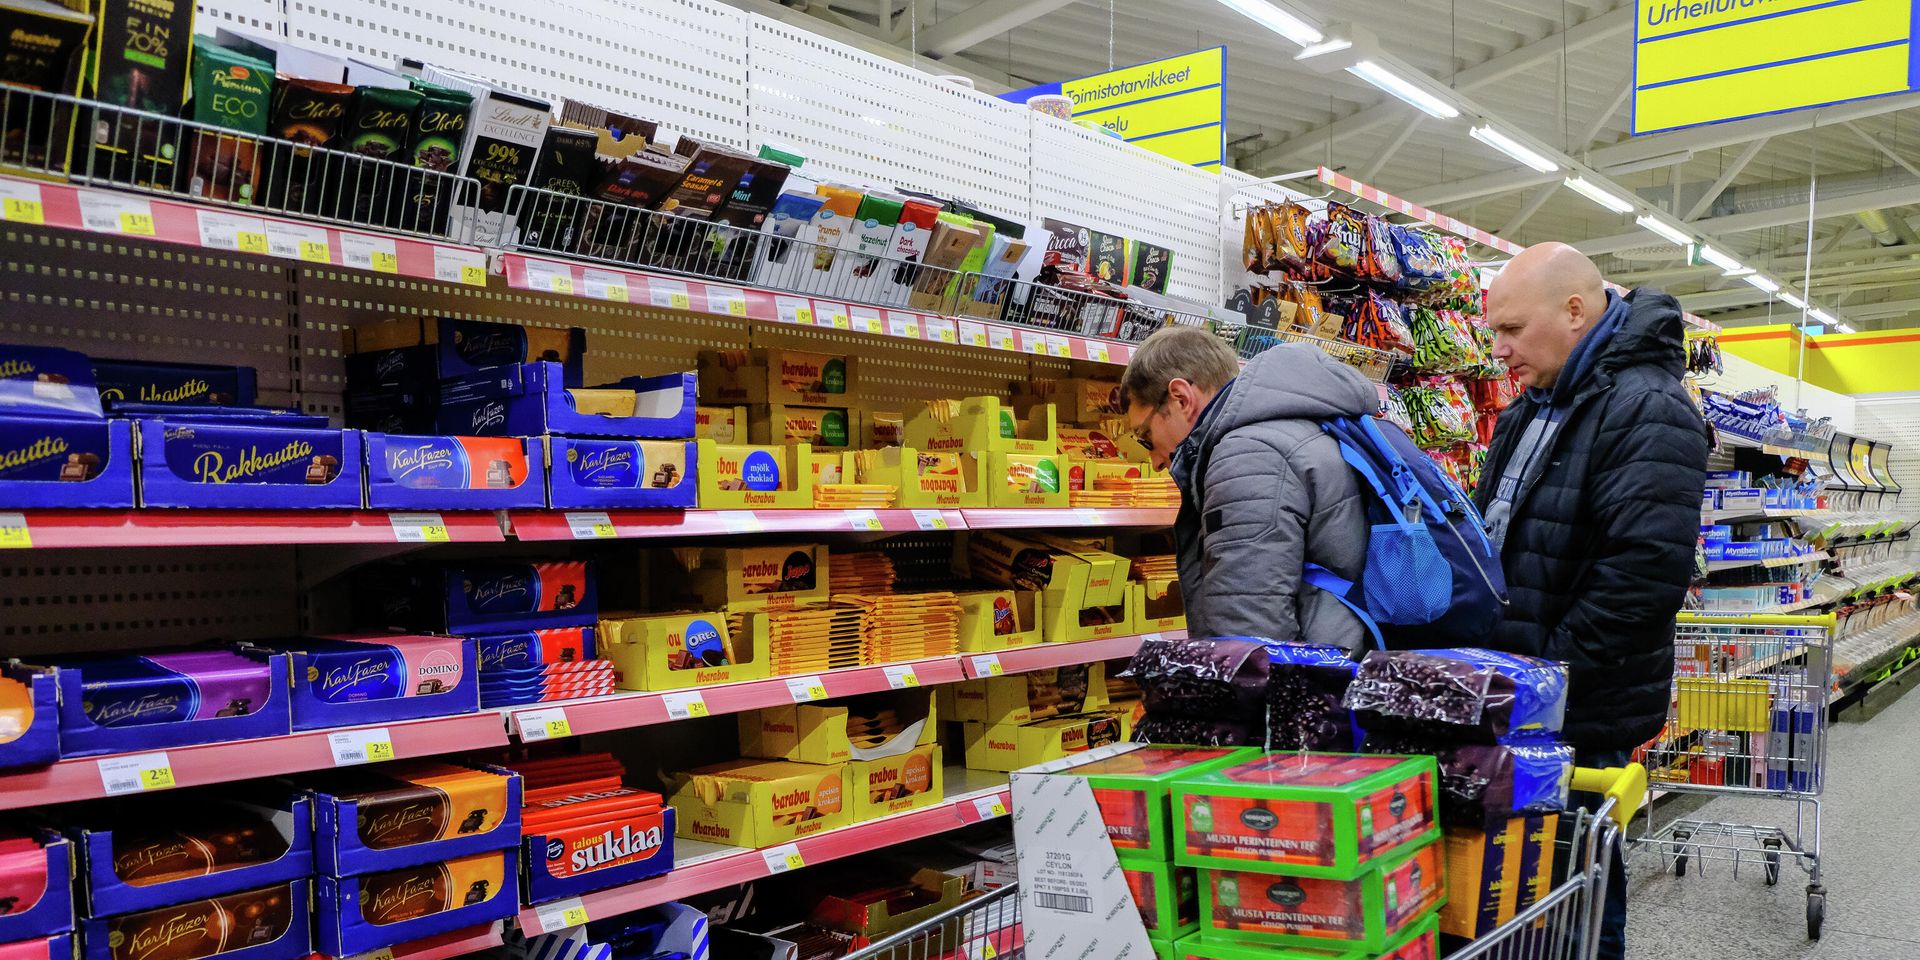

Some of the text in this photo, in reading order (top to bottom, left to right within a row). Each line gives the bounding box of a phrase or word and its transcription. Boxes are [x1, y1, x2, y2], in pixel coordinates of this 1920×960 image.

[127, 17, 170, 39] FIN
[126, 31, 168, 57] 70%
[1066, 66, 1191, 105] Toimistotarvikkeet
[212, 94, 258, 118] ECO
[289, 100, 344, 120] Chef's
[359, 110, 409, 130] Chef's
[419, 111, 465, 132] Chef's
[490, 106, 533, 126] Lindt
[484, 125, 537, 143] EXCELLENCE
[486, 143, 520, 165] 99%
[686, 173, 716, 186] Caramel
[731, 189, 752, 202] Mint
[861, 233, 888, 247] Hazelnut
[899, 235, 914, 247] Dark
[472, 407, 487, 427] Karl
[927, 437, 964, 450] Marabou
[193, 439, 313, 483] Rakkautta
[393, 444, 452, 470] Karl Fazer
[580, 447, 632, 471] Karl Fazer
[747, 473, 774, 482] choklad
[750, 463, 770, 474] mjölk
[744, 492, 776, 503] Marabou
[1725, 546, 1759, 555] Mynthon
[742, 560, 779, 578] arabou
[688, 631, 717, 647] OREO
[498, 639, 529, 663] Fazer
[322, 658, 391, 690] Karl Fazer
[418, 663, 460, 676] DOMINO
[696, 670, 730, 683] Marabou
[96, 693, 181, 722] Karl Fazer
[1061, 727, 1084, 743] arabou
[988, 739, 1017, 751] Marabou
[869, 766, 898, 785] arabou
[817, 796, 840, 807] krokant
[818, 787, 840, 798] apelsin
[367, 804, 435, 836] Karl Fazer
[692, 820, 730, 838] Marabou
[1120, 826, 1133, 835] TEE
[571, 825, 663, 872] suklaa
[573, 834, 603, 850] talous
[1205, 833, 1316, 851] MUSTA PERINTEINEN TEE
[114, 842, 186, 873] Karl Fazer
[1045, 860, 1072, 869] CEYLON
[373, 876, 435, 913] Karl Fazer
[1232, 908, 1345, 926] MUSTA PERINTEINEN TEE
[129, 913, 210, 955] Karl Fazer
